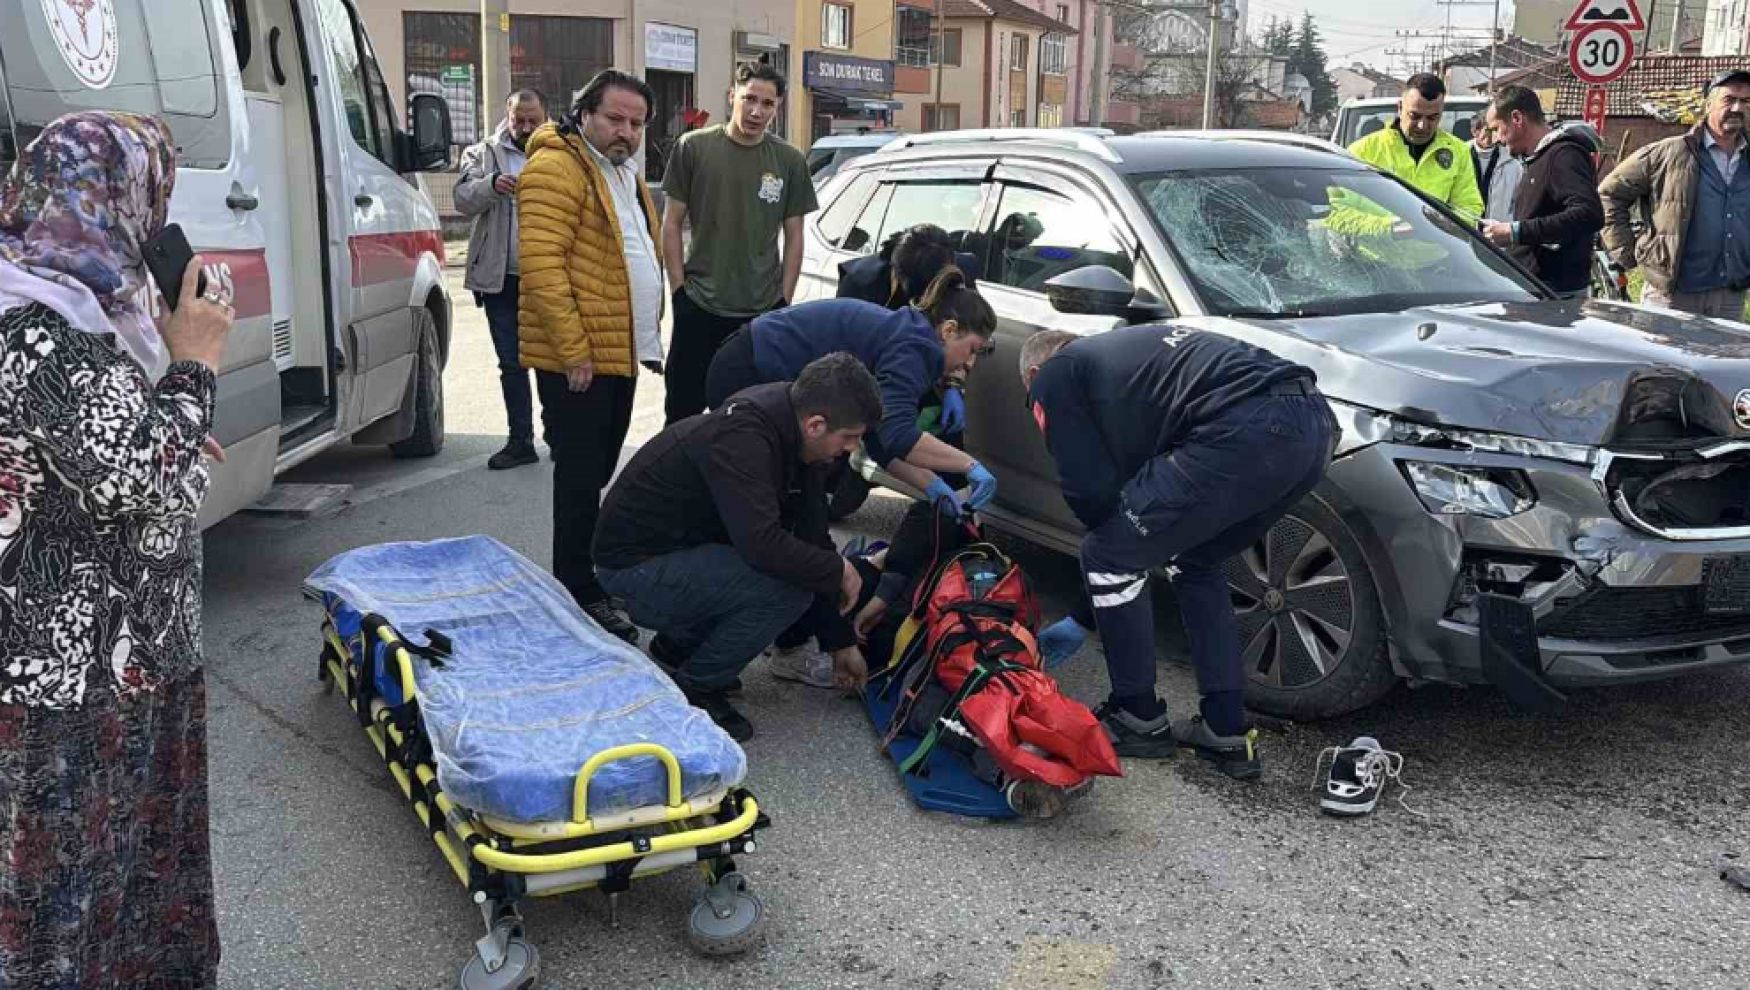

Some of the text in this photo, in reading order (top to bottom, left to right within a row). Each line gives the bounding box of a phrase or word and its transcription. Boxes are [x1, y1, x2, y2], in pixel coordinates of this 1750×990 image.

[1583, 38, 1620, 67] 30
[819, 61, 884, 82] SON DURAK TEKEL
